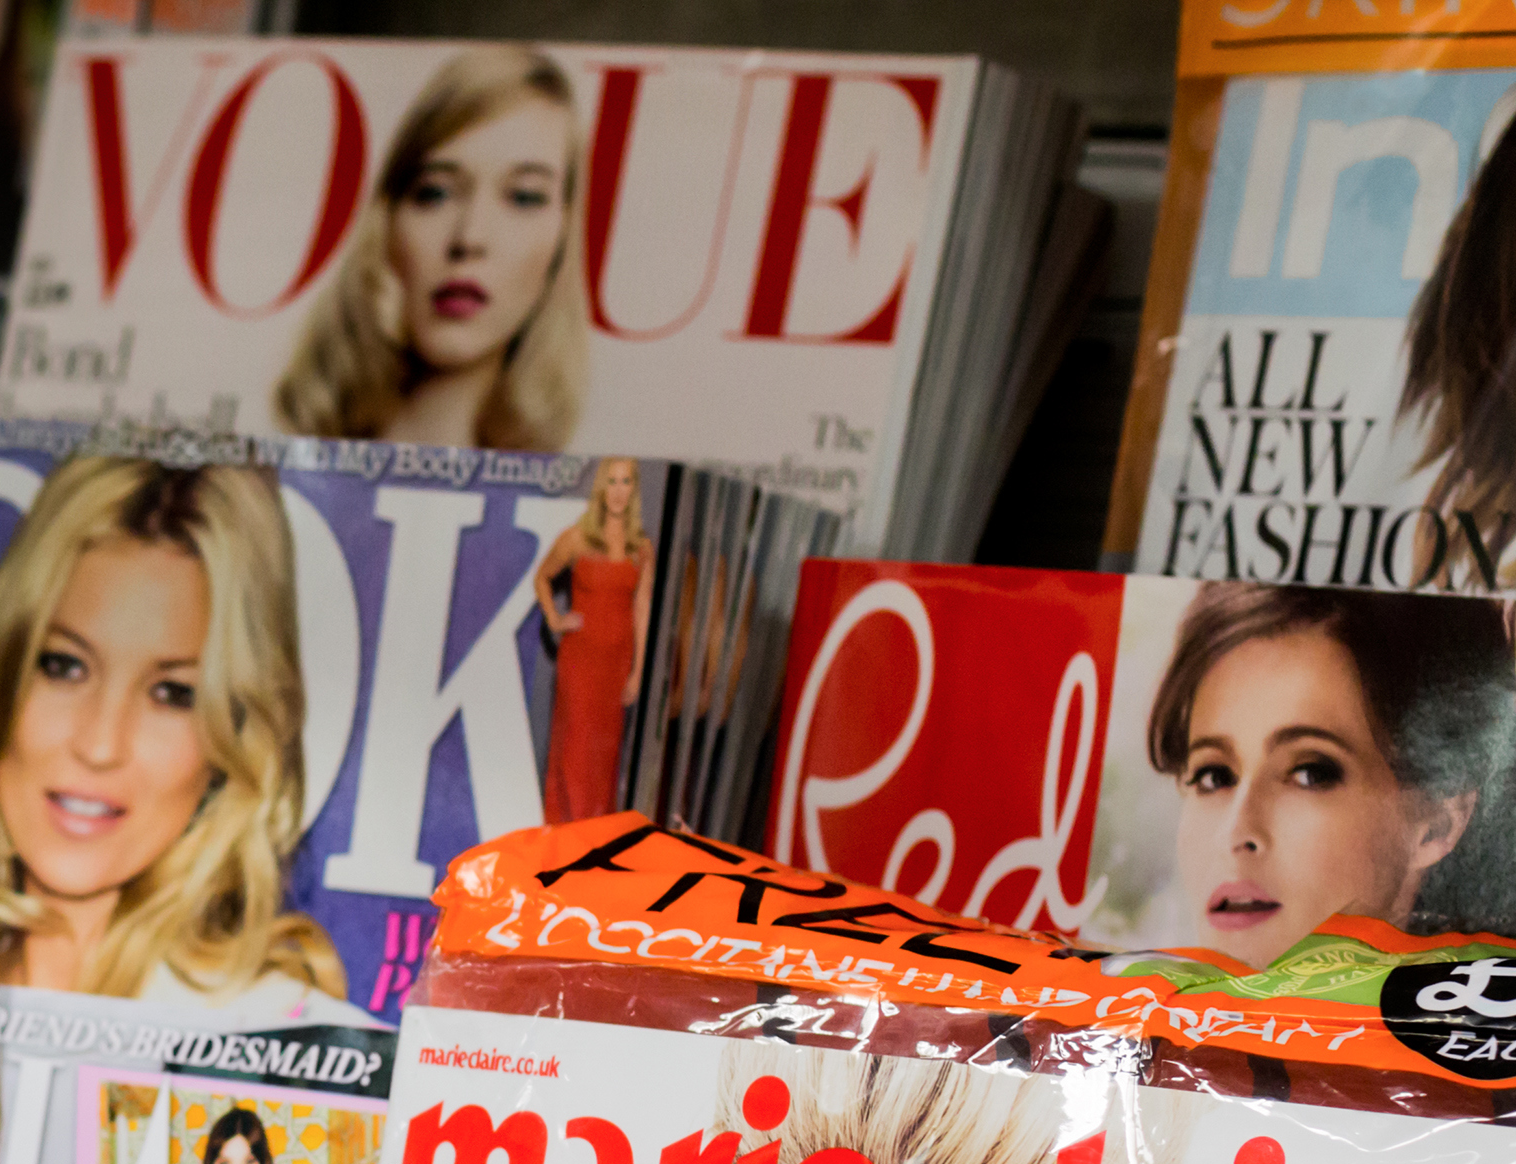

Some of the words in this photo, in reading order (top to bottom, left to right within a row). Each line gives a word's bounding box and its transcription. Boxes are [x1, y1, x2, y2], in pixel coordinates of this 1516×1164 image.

[72, 47, 944, 346] VOUE
[1189, 328, 1346, 412] ALL
[337, 444, 387, 480] My
[393, 445, 480, 487] Body
[482, 452, 588, 492] Image
[1174, 412, 1376, 500] NEW
[1159, 498, 1516, 592] FASHION
[774, 578, 1116, 948] Red
[128, 1022, 383, 1087] BRIDESMAID?
[419, 1043, 561, 1080] marieclaire.co.uk
